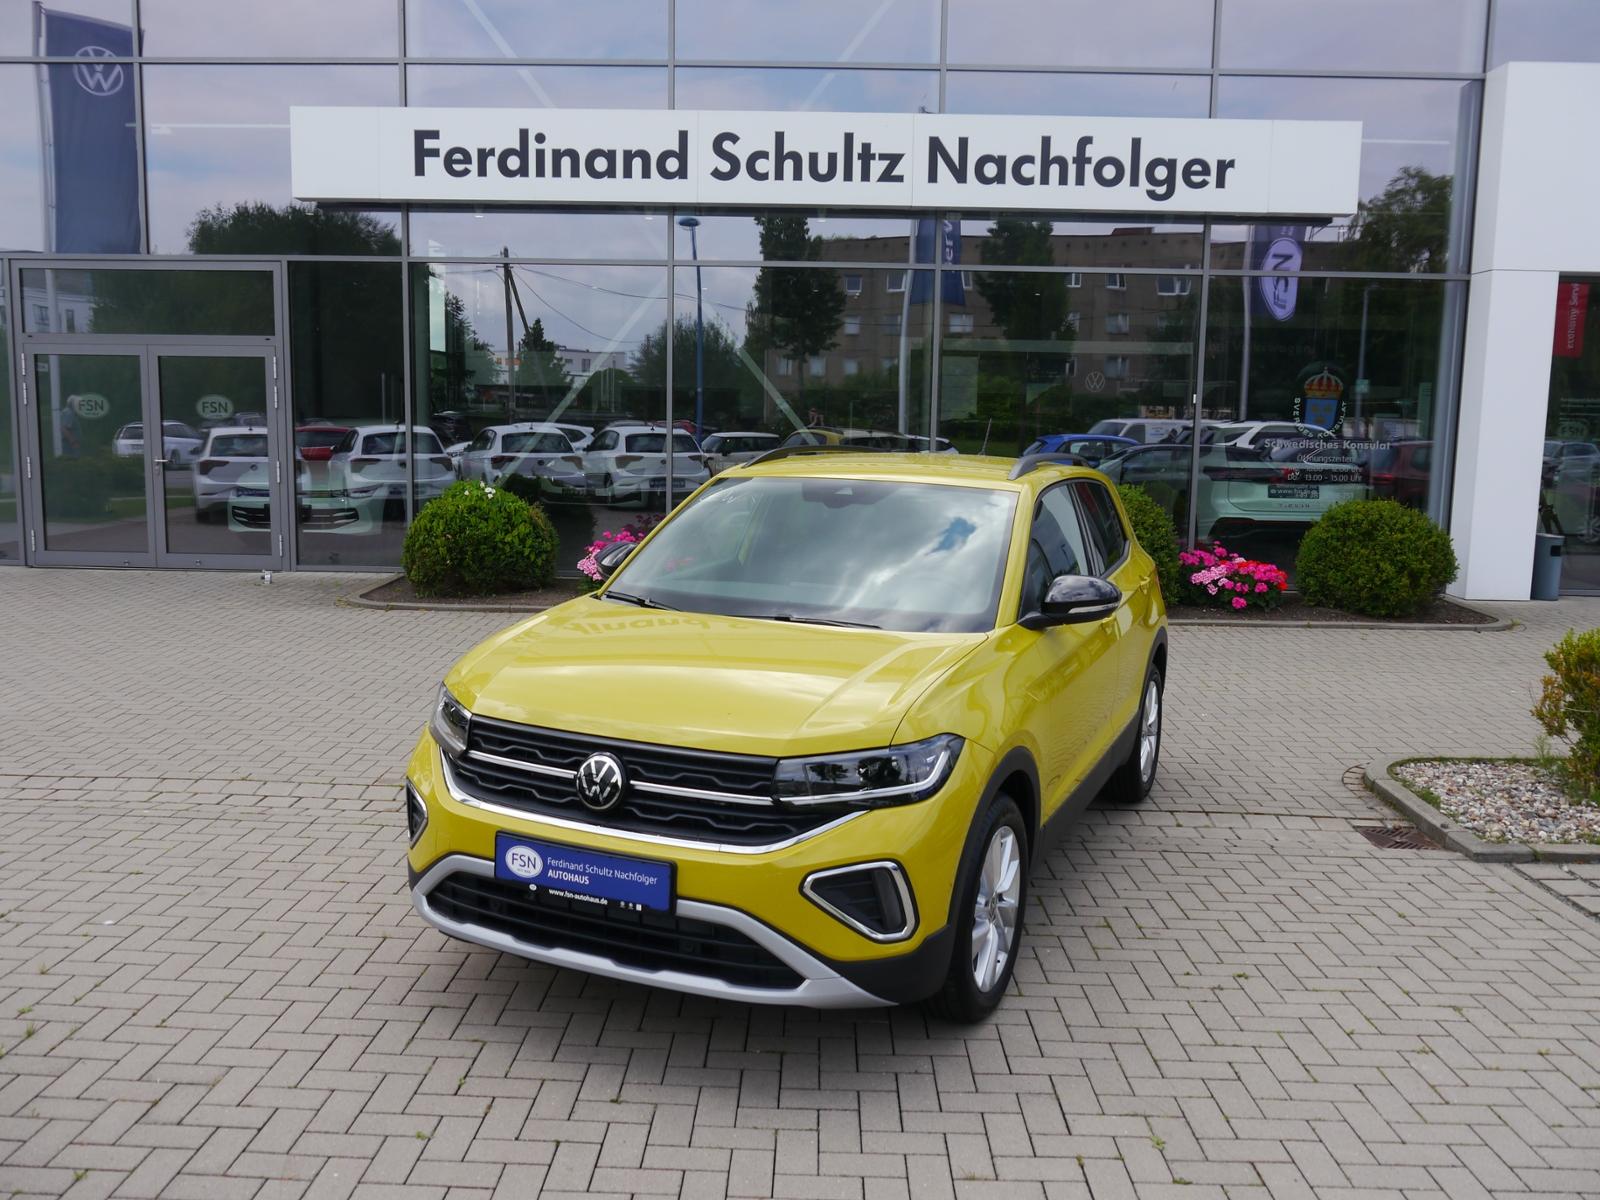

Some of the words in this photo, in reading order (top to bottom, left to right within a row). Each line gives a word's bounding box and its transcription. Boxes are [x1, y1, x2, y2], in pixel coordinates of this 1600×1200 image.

[413, 128, 689, 180] Ferdinand
[710, 131, 906, 183] Schultz
[927, 135, 1236, 202] Nachfolger
[78, 400, 104, 412] FSN
[202, 401, 228, 414] FSN
[1264, 438, 1339, 450] Schwedisches
[1343, 440, 1391, 451] Konsulat
[511, 853, 537, 870] FSN
[547, 857, 584, 872] Ferdinand
[585, 864, 613, 878] Schultz
[614, 870, 658, 886] Nachfolger
[547, 869, 590, 885] AUTOHAUS
[548, 888, 608, 905] www.fsn-autohaus.de
